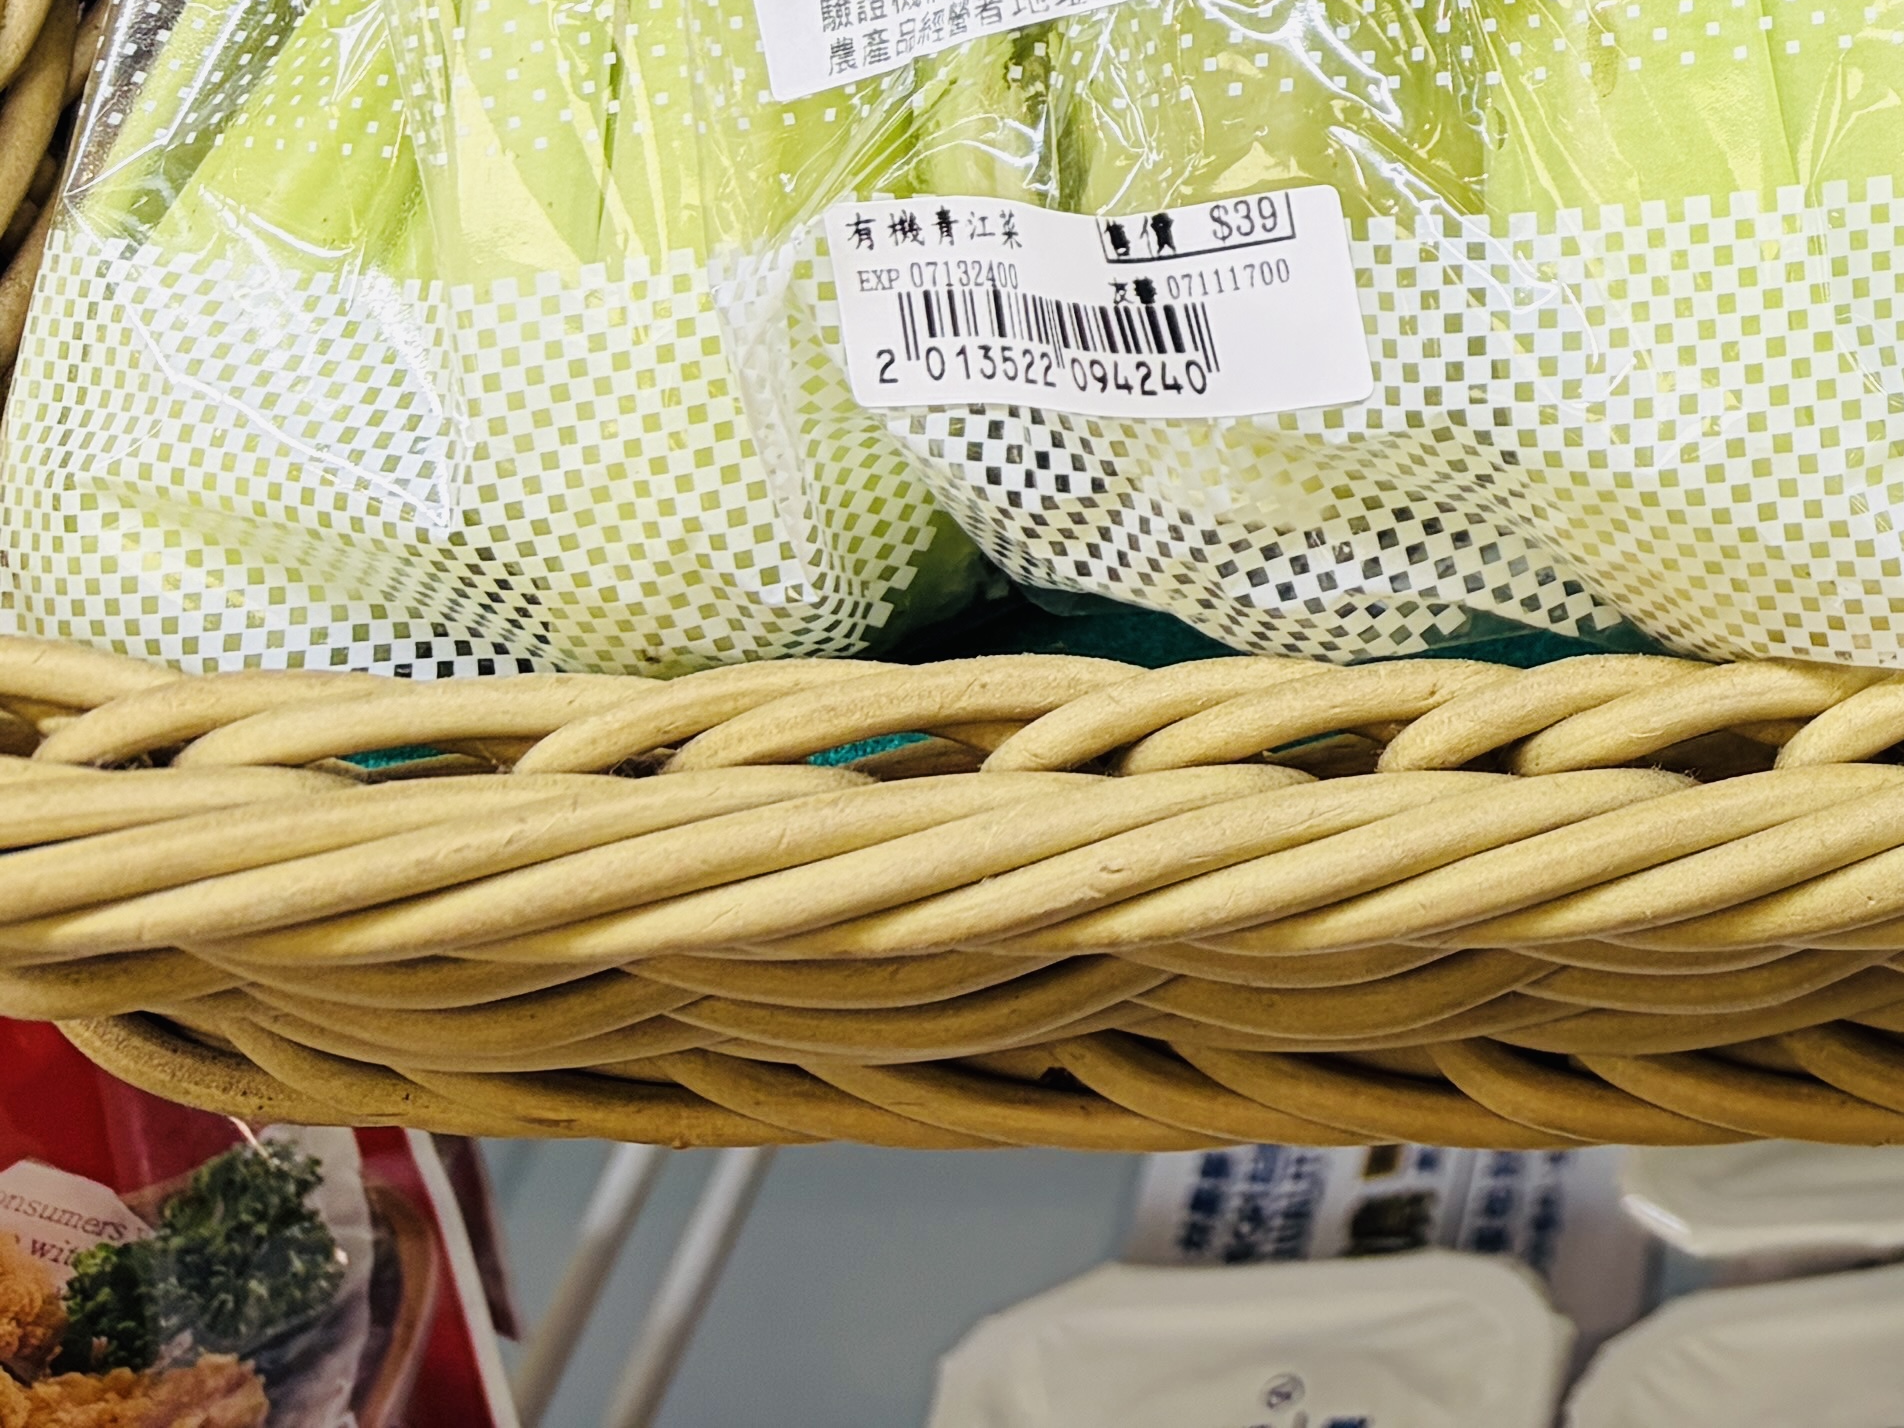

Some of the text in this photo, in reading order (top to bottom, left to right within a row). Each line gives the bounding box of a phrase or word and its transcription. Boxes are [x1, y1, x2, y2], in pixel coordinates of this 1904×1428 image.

[844, 205, 1024, 251] 有機青江菜
[1209, 195, 1279, 244] $39
[856, 259, 1020, 293] EXP 07132400
[1166, 257, 1291, 301] 07111700
[875, 344, 1209, 396] 2 013522 094240
